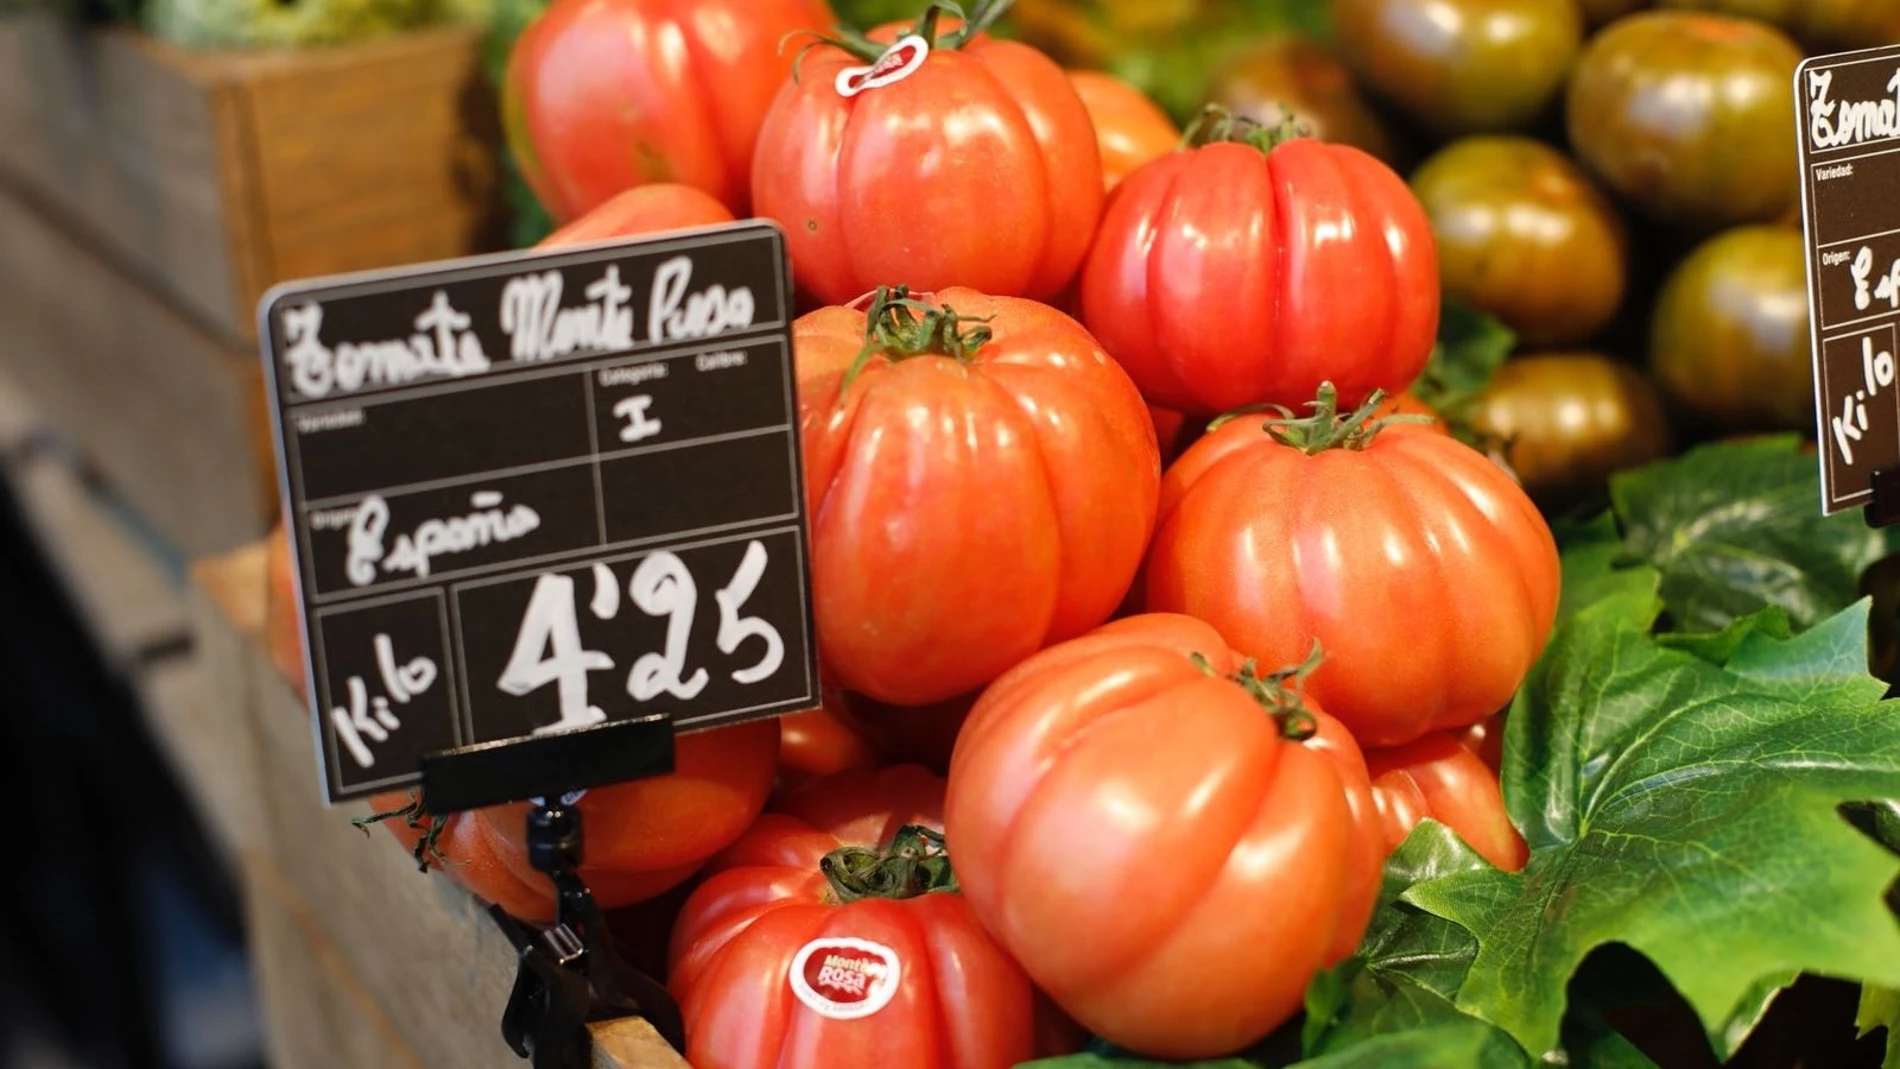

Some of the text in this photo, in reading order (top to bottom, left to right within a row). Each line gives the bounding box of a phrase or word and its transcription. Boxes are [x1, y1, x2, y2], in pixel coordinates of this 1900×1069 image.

[1815, 163, 1853, 181] Variedad:
[1822, 250, 1851, 267] Origen:
[499, 263, 634, 362] Monte
[612, 394, 662, 443] I
[1832, 336, 1894, 465] Kilo
[345, 490, 541, 586] España
[497, 540, 785, 735] 4'25
[331, 634, 437, 768] Kilo
